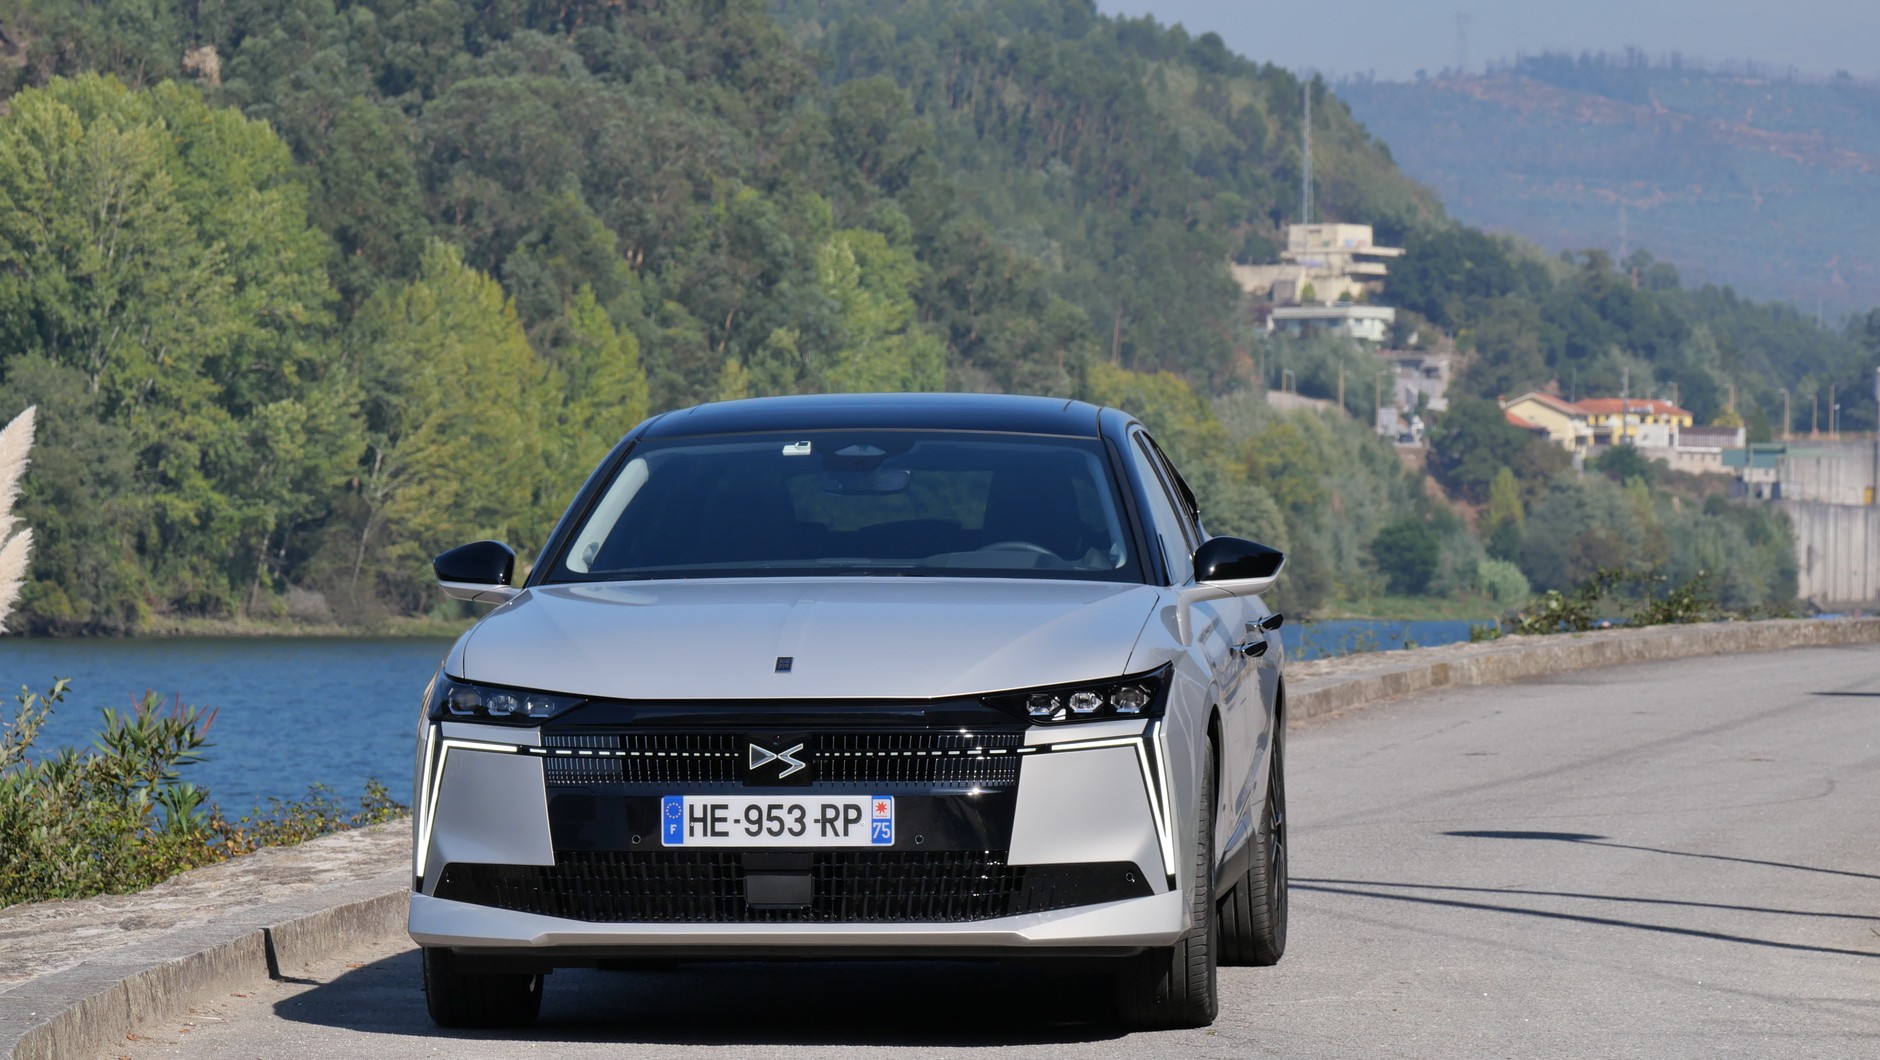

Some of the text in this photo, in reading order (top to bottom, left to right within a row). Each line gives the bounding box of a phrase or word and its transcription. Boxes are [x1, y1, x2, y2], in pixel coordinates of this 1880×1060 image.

[750, 743, 806, 779] DS
[670, 824, 677, 835] F
[689, 803, 863, 837] HE-953-RP
[873, 822, 891, 839] 75
